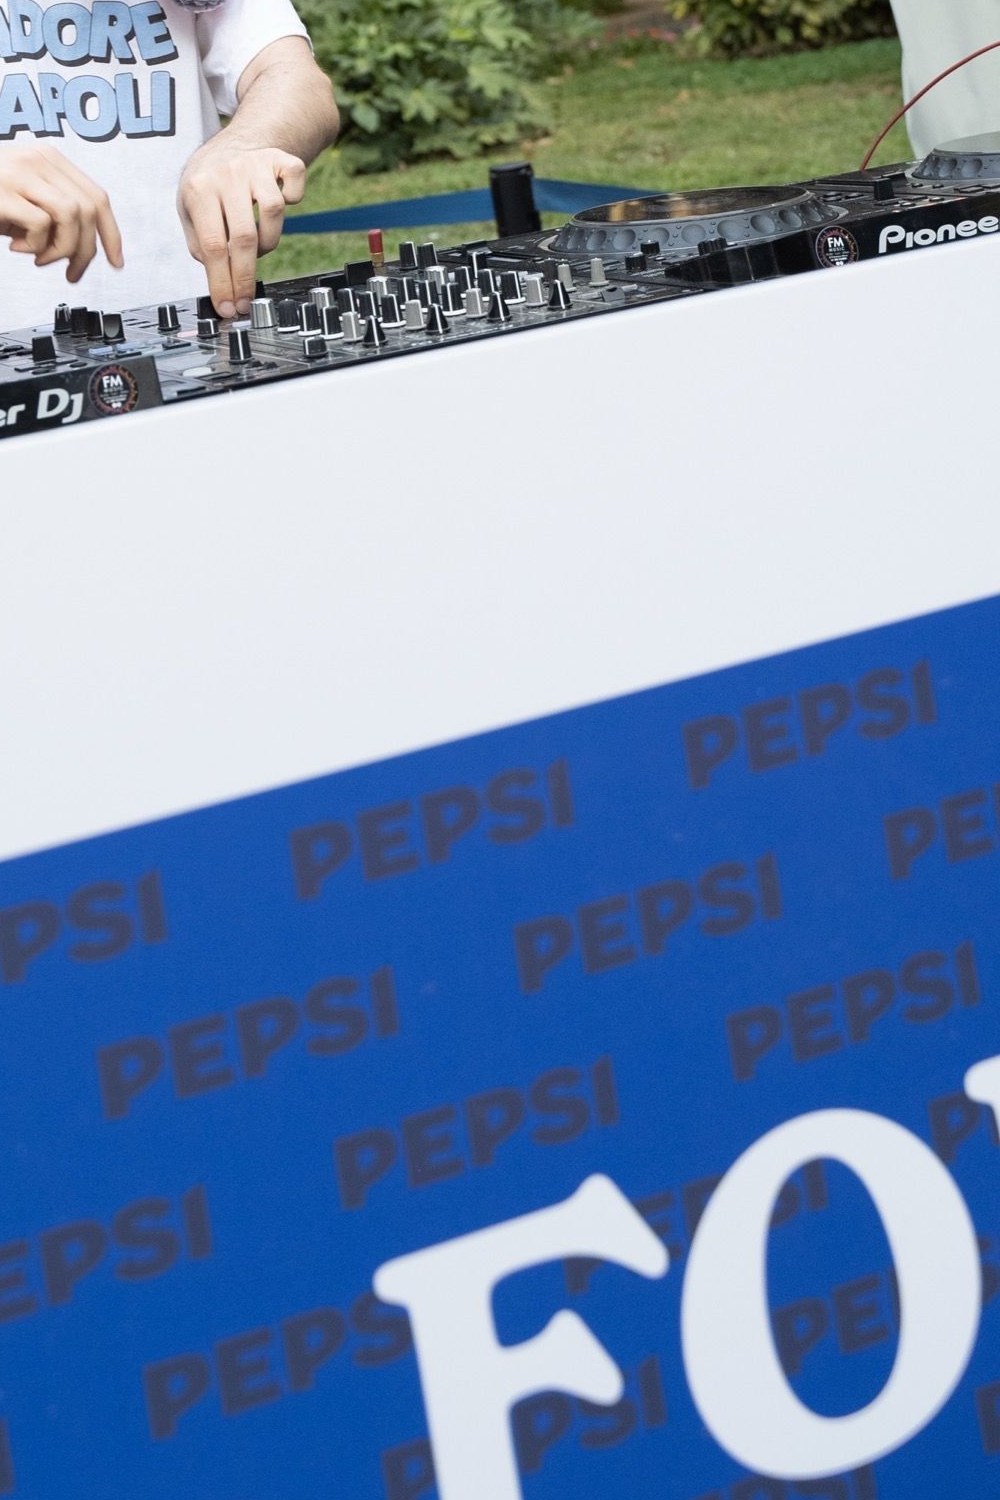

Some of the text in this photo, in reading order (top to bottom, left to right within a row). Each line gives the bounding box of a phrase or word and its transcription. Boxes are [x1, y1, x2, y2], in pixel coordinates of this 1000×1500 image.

[827, 236, 845, 248] FM
[102, 375, 124, 389] FM
[682, 659, 937, 790] PEPSI
[289, 760, 574, 900] PEPSI
[514, 853, 782, 993] PEPSI
[97, 967, 399, 1119] PEPSI
[726, 942, 980, 1081] PEPSI
[335, 1057, 619, 1210] PEPSI
